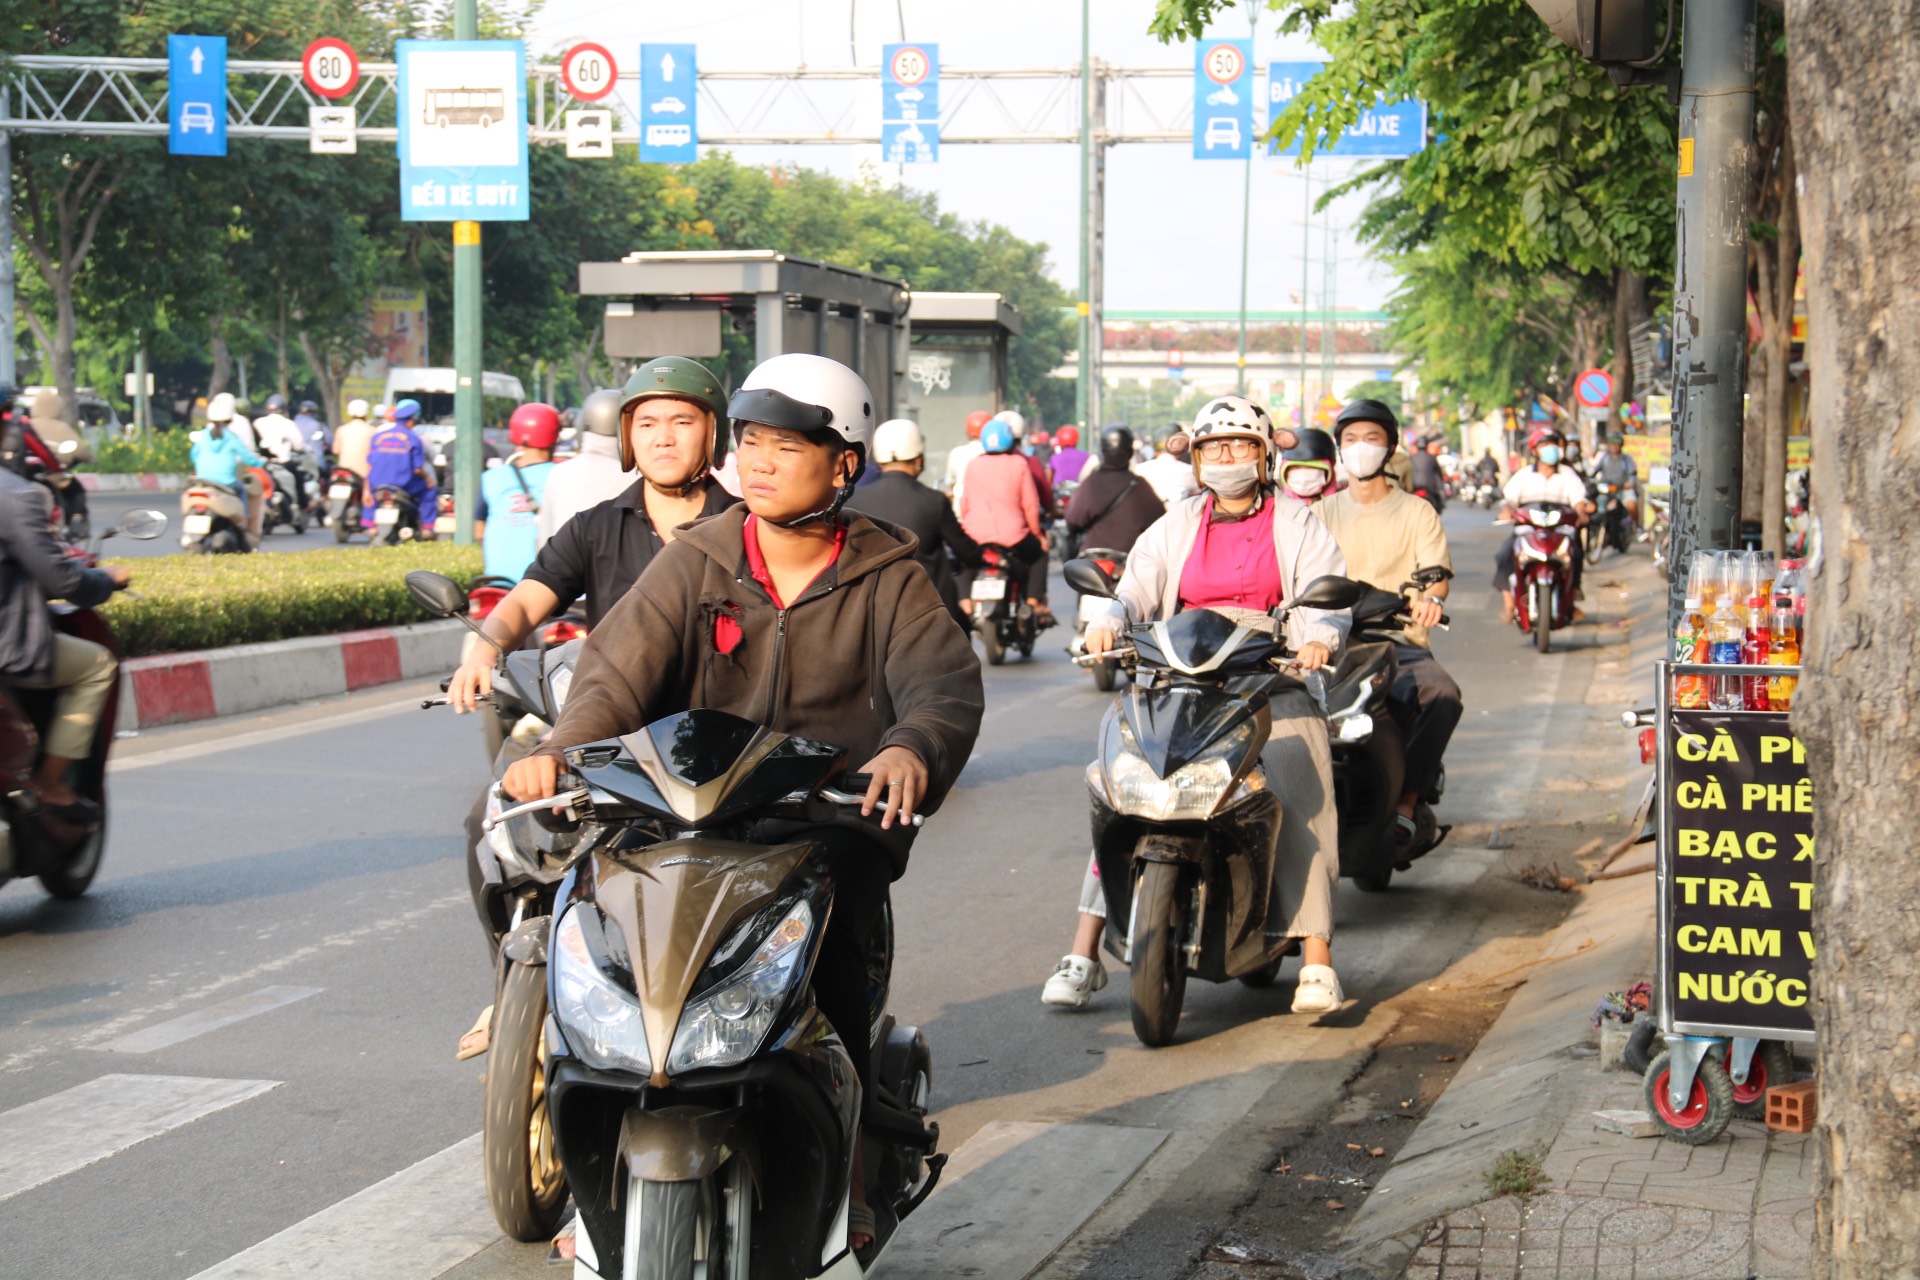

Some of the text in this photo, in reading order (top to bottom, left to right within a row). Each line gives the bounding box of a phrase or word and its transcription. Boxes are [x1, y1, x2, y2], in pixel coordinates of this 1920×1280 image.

[319, 56, 341, 78] 80
[578, 59, 600, 82] 60
[901, 57, 918, 76] 50
[1216, 54, 1233, 73] 50
[1350, 110, 1377, 136] LÁI
[1378, 115, 1400, 136] XE
[450, 184, 473, 206] XE
[476, 180, 518, 206] BUÝT
[1675, 640, 1695, 665] C2
[1676, 727, 1740, 762] CÀ
[1676, 775, 1813, 813] CÀ PHÊ
[1678, 829, 1777, 864] BẠC
[1675, 872, 1772, 909] TRÀ
[1676, 924, 1781, 957] CAM
[1678, 969, 1807, 1007] NƯỚC
